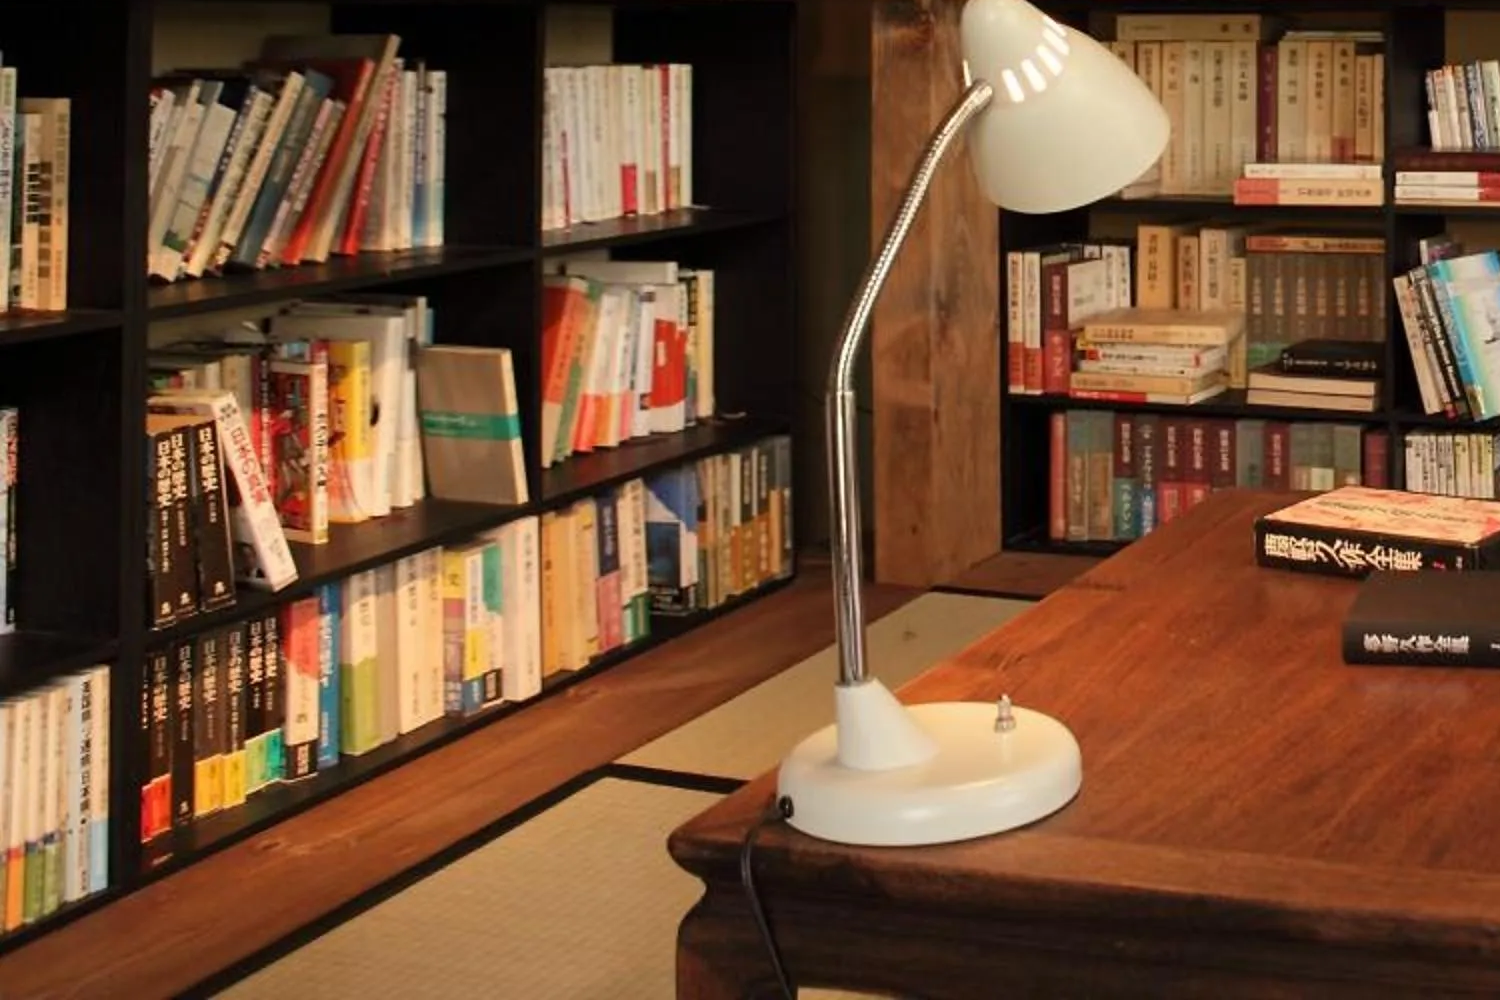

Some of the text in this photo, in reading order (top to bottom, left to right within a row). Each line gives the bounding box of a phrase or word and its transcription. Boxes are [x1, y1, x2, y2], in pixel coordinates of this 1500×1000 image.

[157, 439, 173, 509] 日本の歴史
[171, 432, 188, 500] 日本の歴史
[200, 426, 219, 494] 日本の歴史
